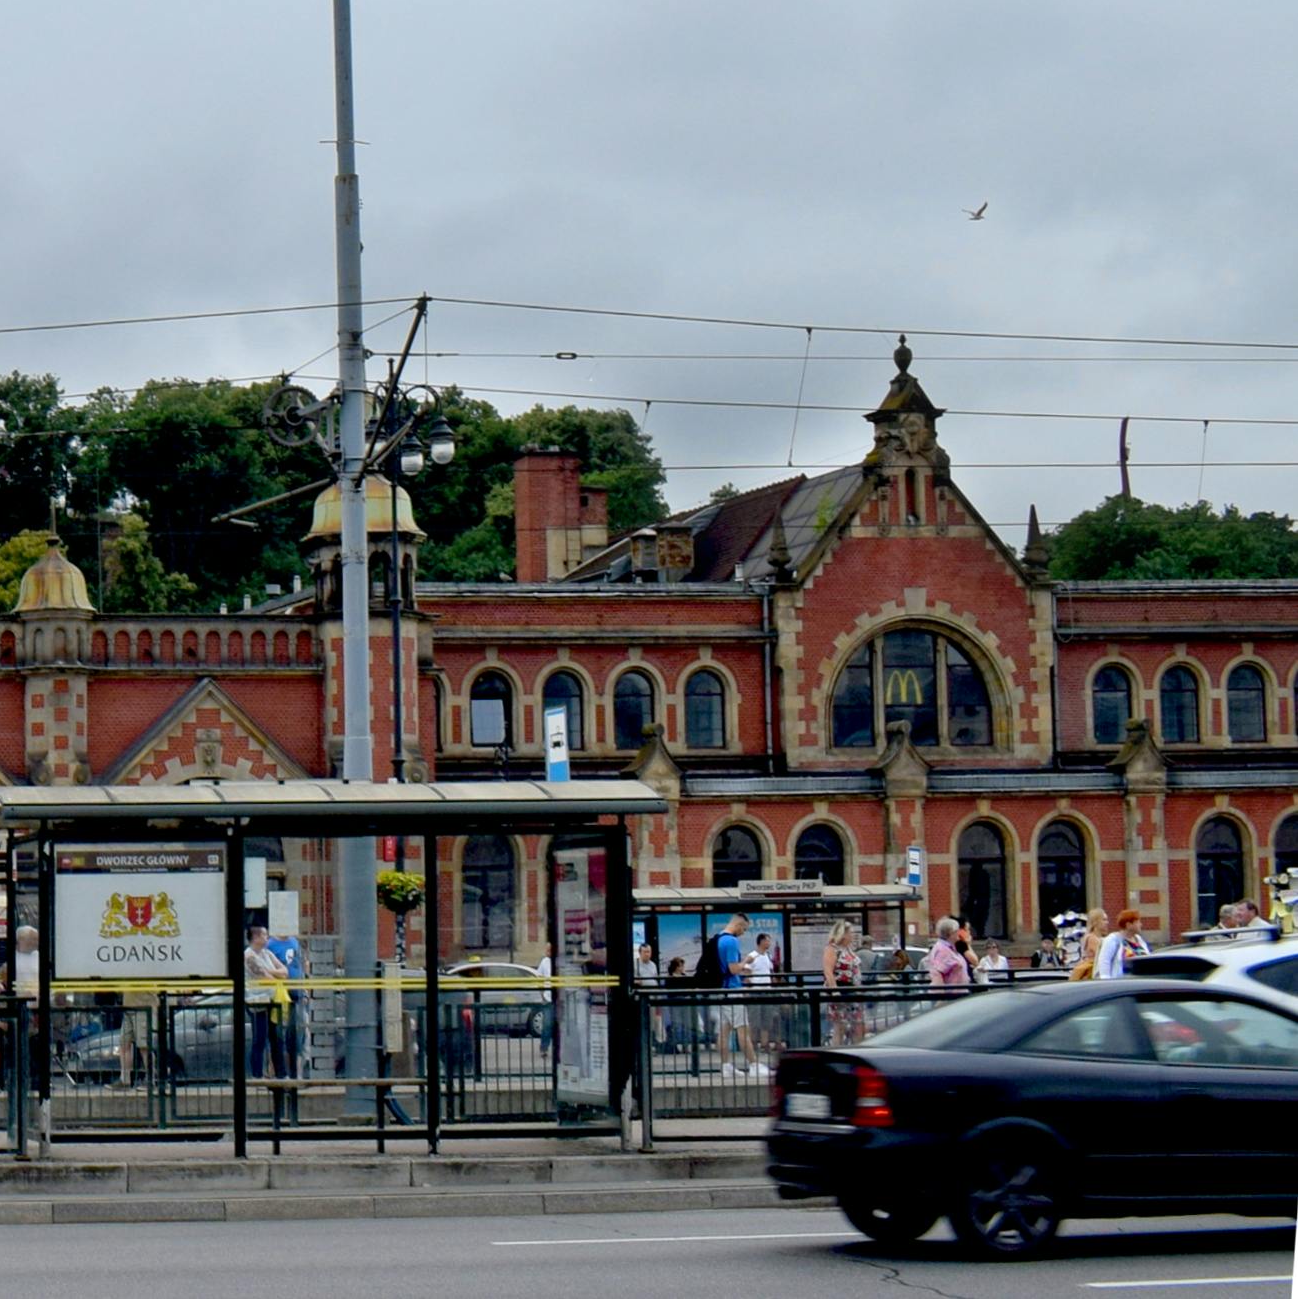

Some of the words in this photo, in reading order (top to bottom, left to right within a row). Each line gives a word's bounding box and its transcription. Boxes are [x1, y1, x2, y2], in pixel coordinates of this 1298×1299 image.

[96, 855, 145, 866] DWORZEC
[147, 854, 189, 866] GŁÓWNY
[96, 941, 183, 962] GDAŃSK
